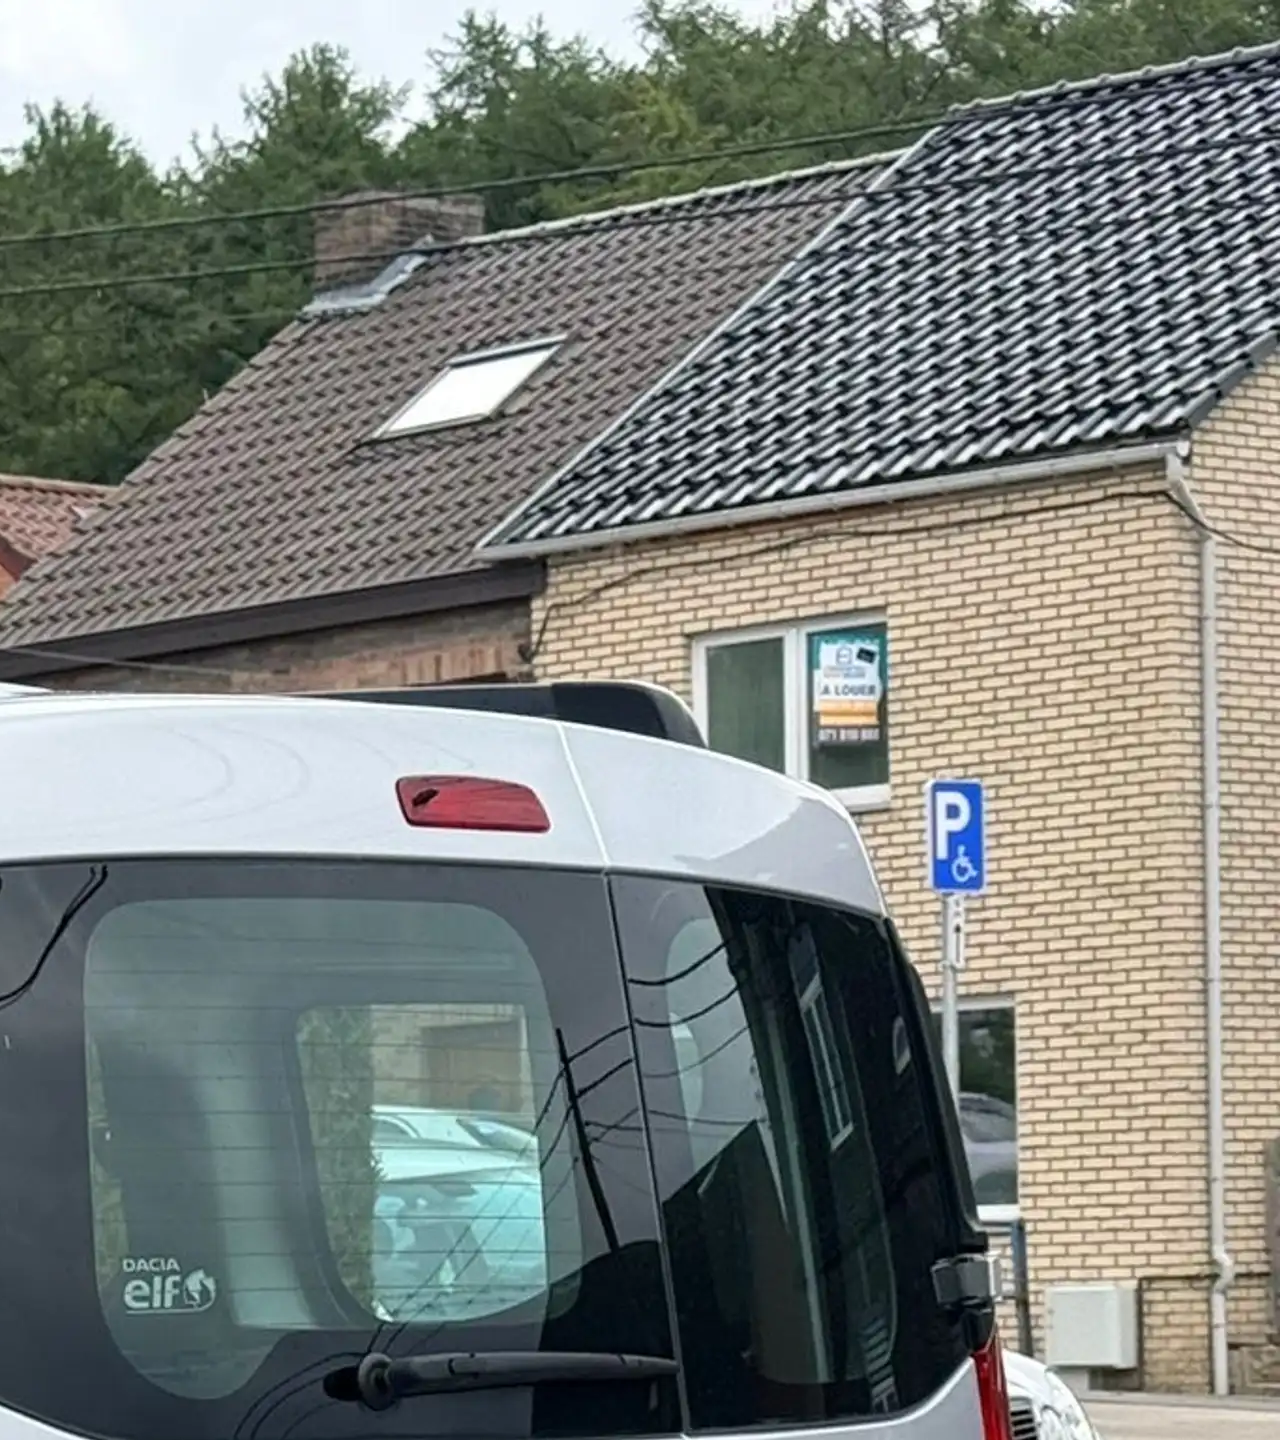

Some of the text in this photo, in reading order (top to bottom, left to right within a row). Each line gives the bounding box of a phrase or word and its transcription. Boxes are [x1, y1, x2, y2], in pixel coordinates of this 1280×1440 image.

[935, 791, 971, 860] P
[123, 1257, 180, 1272] DACIA
[124, 1275, 181, 1309] elf
